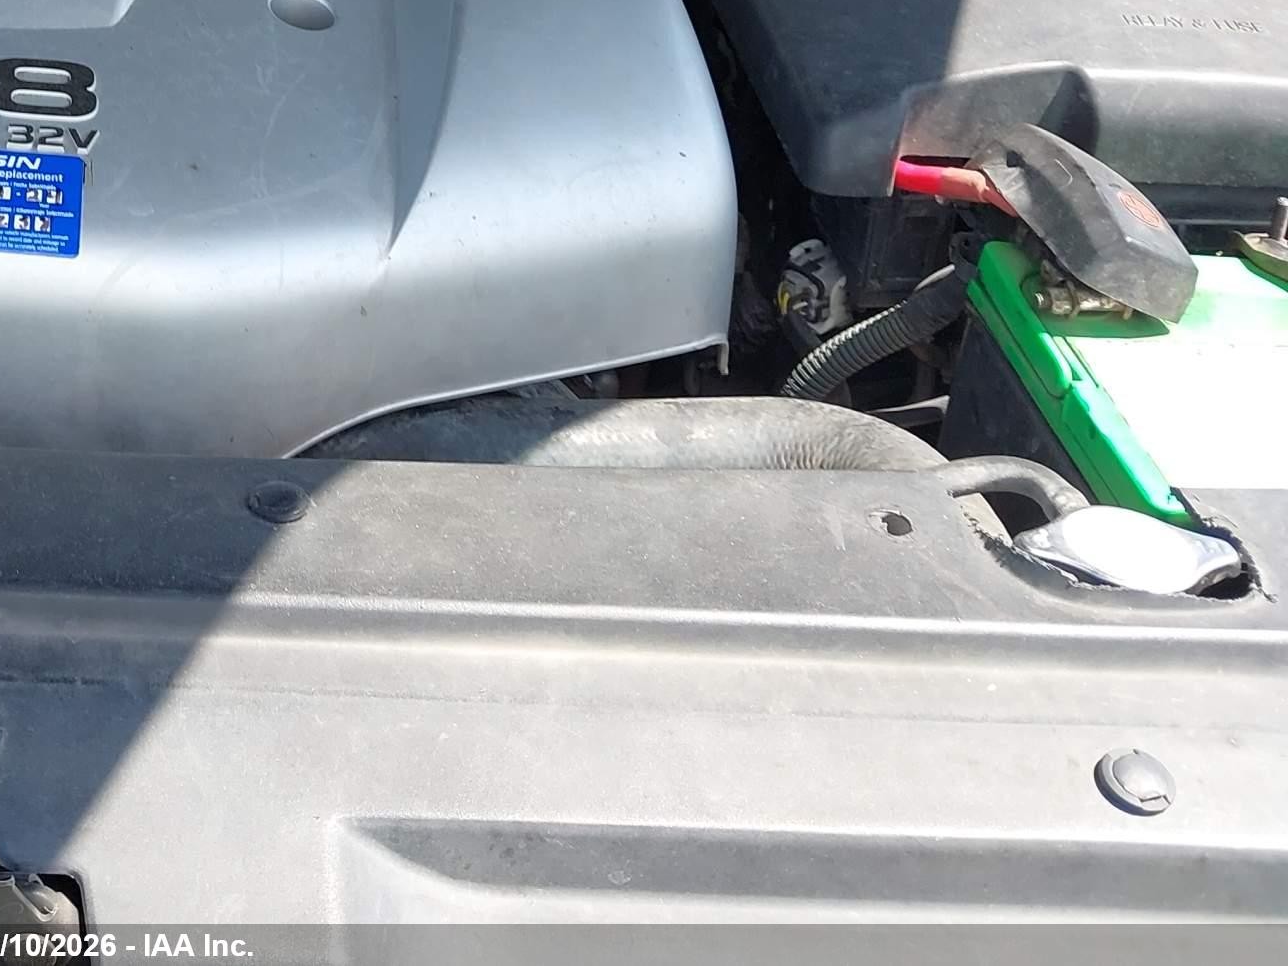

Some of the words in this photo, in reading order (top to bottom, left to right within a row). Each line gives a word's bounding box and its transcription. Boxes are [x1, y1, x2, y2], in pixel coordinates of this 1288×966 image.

[1122, 13, 1184, 29] RELAY
[1192, 18, 1205, 29] &
[1212, 17, 1263, 33] FUSE
[6, 123, 100, 154] 32V
